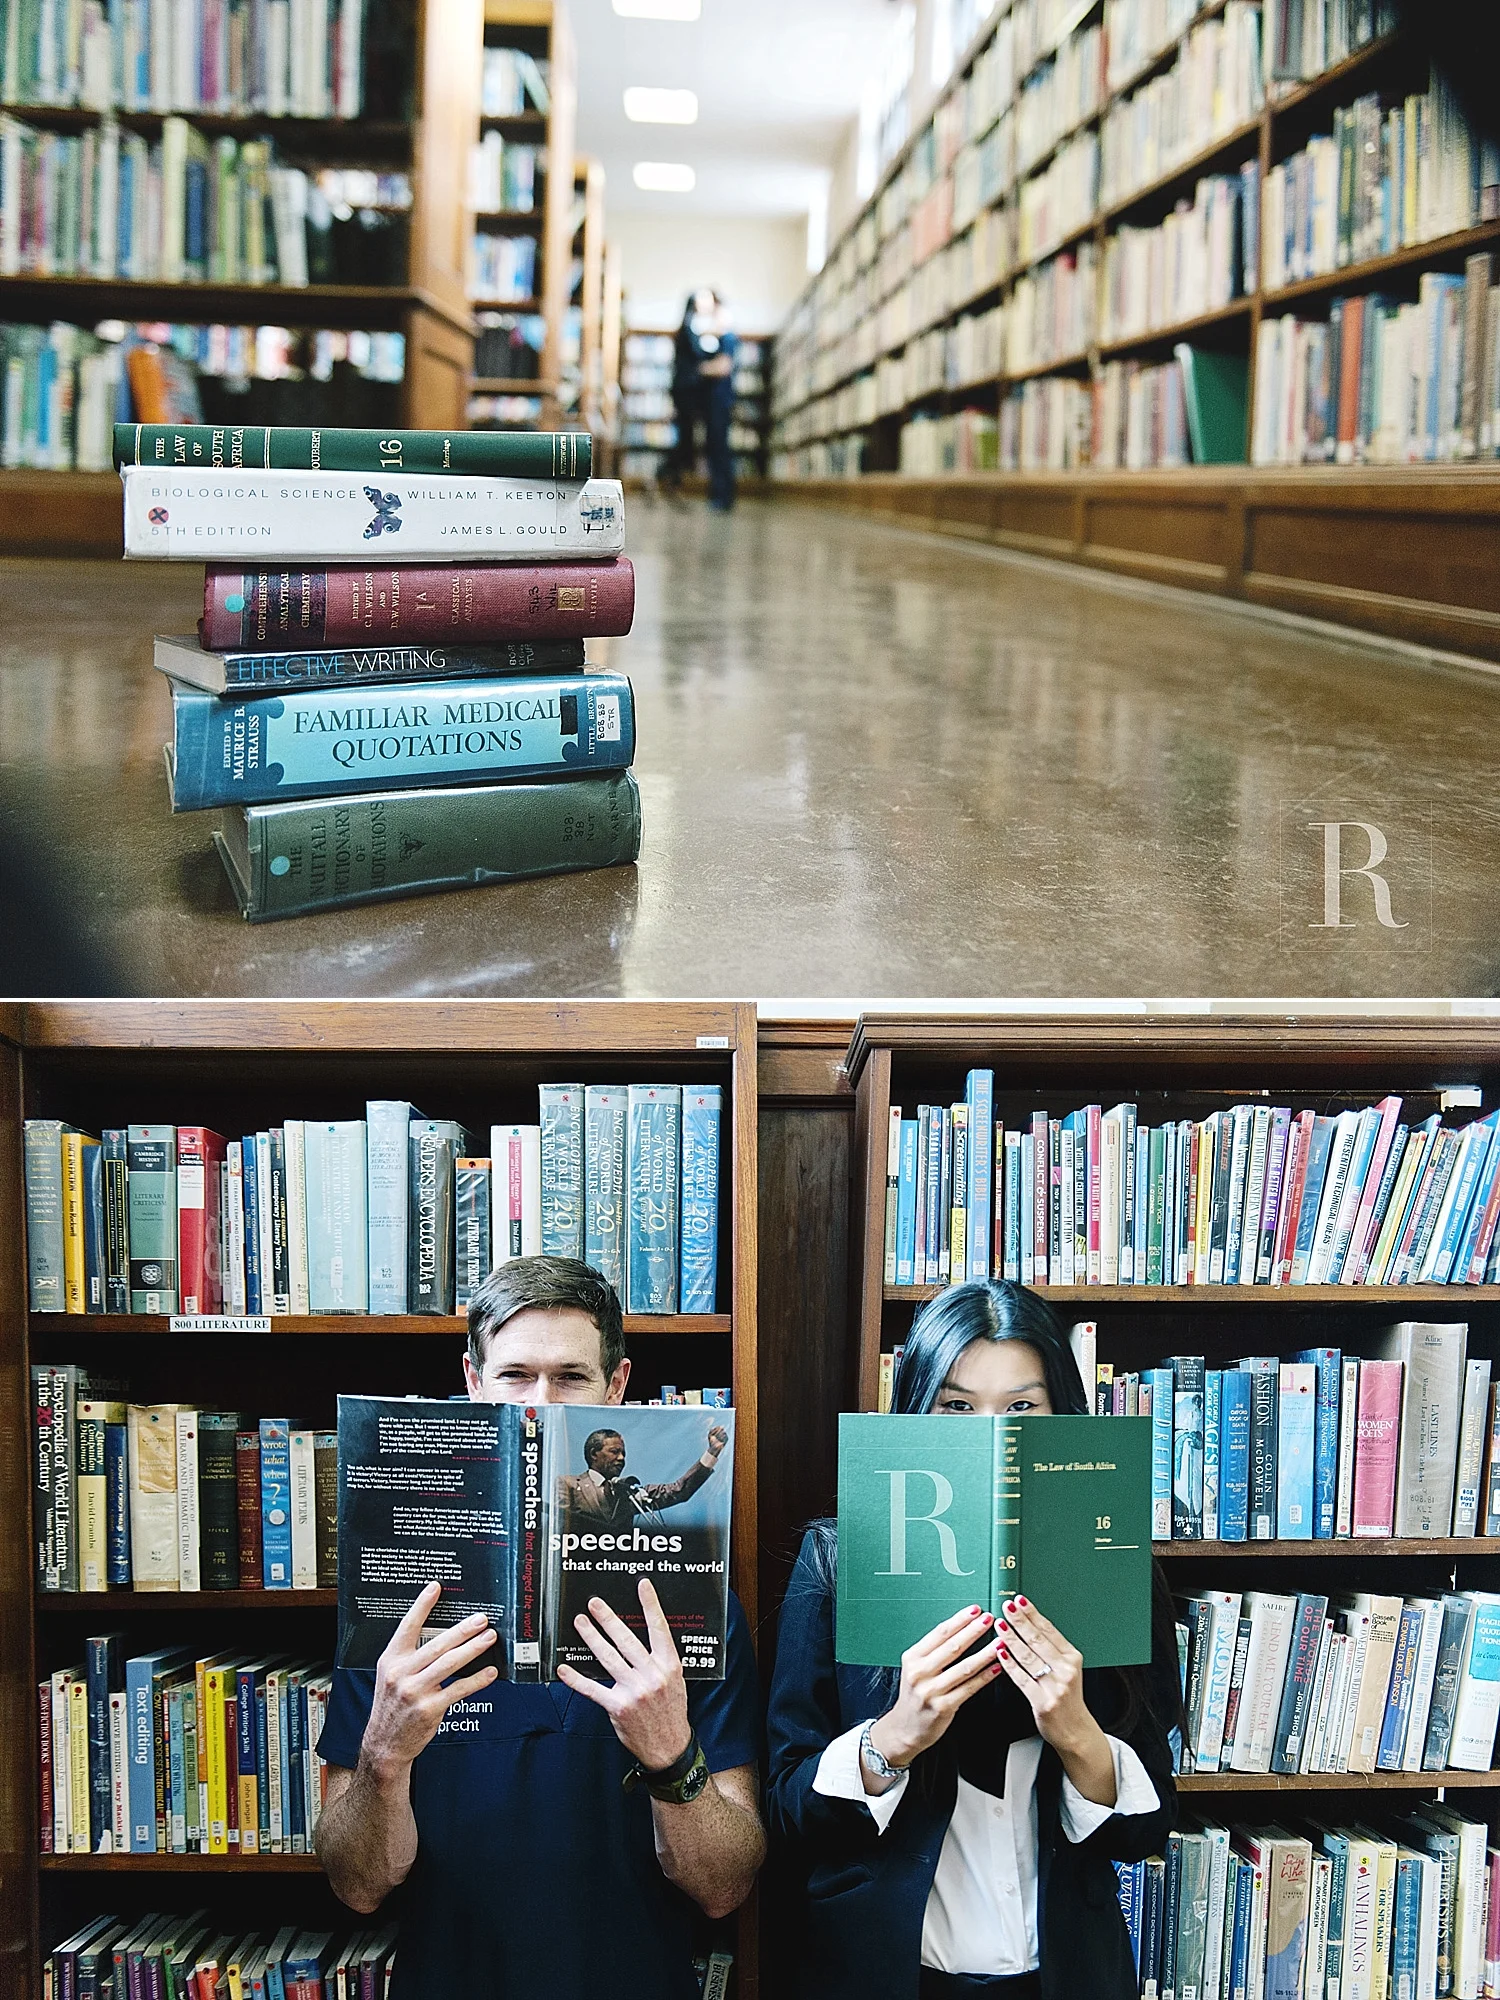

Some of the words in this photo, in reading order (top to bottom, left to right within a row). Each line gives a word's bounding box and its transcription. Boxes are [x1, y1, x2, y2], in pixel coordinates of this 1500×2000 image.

[155, 438, 165, 459] THE
[174, 435, 186, 463] LAW
[193, 442, 202, 457] OF
[379, 439, 403, 468] 16
[151, 487, 269, 499] BIOLOGICAL
[280, 489, 357, 499] SCIENCE
[407, 490, 477, 500] WILLIAM
[486, 490, 499, 500] T.
[505, 491, 567, 500] KEETON
[151, 526, 187, 536] 5TH
[194, 526, 272, 536] EDITION
[440, 525, 493, 535] JAMES
[499, 526, 512, 535] L.
[516, 525, 567, 535] GOULD
[280, 571, 289, 631] ANALYTICAL
[301, 572, 310, 628] CHEMISTRY
[365, 572, 373, 609] WILSON
[451, 576, 460, 625] CLASSICAL
[465, 578, 473, 622] ANALYSIS
[238, 655, 345, 681] EFFECTIVE
[352, 649, 446, 673] WRITING
[234, 706, 245, 719] B.
[293, 705, 431, 734] FAMILIAR
[443, 698, 561, 725] MEDICAL
[587, 688, 596, 722] BROWN
[607, 707, 615, 730] STR
[223, 720, 231, 732] BY
[223, 735, 231, 768] EDITED
[233, 722, 245, 780] MAURICE
[247, 715, 260, 769] STRAUSS
[332, 729, 522, 768] QUOTATIONS
[290, 847, 302, 876] THE
[311, 819, 326, 898] NUTTALL
[355, 844, 366, 863] OF
[975, 1079, 989, 1095] THE
[598, 1137, 611, 1147] of
[651, 1135, 664, 1144] of
[665, 1106, 675, 1193] ENCYCLOPEDIA
[975, 1097, 989, 1174] SCREENWRITER'S
[419, 1130, 438, 1185] READERS
[588, 1122, 598, 1195] LITERATURE
[612, 1110, 623, 1195] ENCYCLOPEDIA
[640, 1120, 650, 1192] LITERATURE
[1036, 1140, 1045, 1184] CONFLICT
[1271, 1134, 1285, 1169] BUILDING
[1336, 1134, 1354, 1180] PRESENTING
[600, 1150, 611, 1195] WORLD
[652, 1147, 662, 1192] WORLD
[953, 1130, 967, 1205] Screenwriting
[271, 1170, 281, 1218] Contemporary
[974, 1177, 988, 1202] BIBLE
[1035, 1186, 1046, 1197] &
[1267, 1170, 1281, 1197] BETTER
[1264, 1199, 1277, 1222] PLOTS
[1327, 1181, 1344, 1220] TECHNICAL
[273, 1219, 281, 1245] Literary
[588, 1200, 596, 1235] CENTURY
[1036, 1198, 1045, 1244] SUSPENSE
[419, 1190, 435, 1281] ENCYCLOPEDIA
[467, 1217, 479, 1258] LITERARY
[1322, 1222, 1334, 1245] IDEAS
[273, 1246, 282, 1271] Theory
[467, 1259, 479, 1288] TERMS
[174, 1320, 192, 1329] 800
[194, 1320, 269, 1330] LITERATURE
[1424, 1334, 1443, 1344] Kline
[38, 1373, 51, 1386] in
[37, 1387, 51, 1407] the
[47, 1373, 68, 1448] Encyclopedia
[1357, 1420, 1394, 1430] WOMEN
[1429, 1404, 1440, 1428] LAST
[179, 1425, 188, 1463] LITERARY
[262, 1441, 286, 1450] wrote
[1204, 1419, 1219, 1464] AGES
[1321, 1413, 1330, 1457] MENAGERIE
[1357, 1429, 1384, 1438] POETS
[1429, 1430, 1439, 1458] LINES
[33, 1441, 52, 1492] Century
[53, 1455, 68, 1468] of
[264, 1456, 285, 1465] what
[1033, 1463, 1048, 1472] The
[1048, 1463, 1064, 1472] Law
[1073, 1462, 1095, 1471] South
[1095, 1462, 1117, 1471] Africa
[1154, 1417, 1170, 1495] DREAMS
[264, 1470, 288, 1479] when
[521, 1442, 541, 1530] speeches
[1254, 1439, 1264, 1508] McDOWELL
[1264, 1454, 1273, 1493] COLIN
[54, 1471, 69, 1509] World
[88, 1492, 96, 1516] David
[181, 1488, 189, 1531] THEMATIC
[1095, 1516, 1111, 1530] 16
[55, 1510, 70, 1571] Literature
[181, 1533, 190, 1561] TERMS
[525, 1531, 535, 1552] that
[549, 1528, 682, 1558] speeches
[522, 1554, 535, 1593] changed
[562, 1559, 592, 1571] that
[595, 1560, 654, 1574] changed
[657, 1560, 681, 1572] the
[685, 1560, 724, 1573] world
[999, 1556, 1016, 1570] 16
[524, 1595, 534, 1609] the
[1304, 1605, 1314, 1622] OF
[524, 1611, 534, 1638] world
[1197, 1615, 1206, 1633] 20th
[1312, 1607, 1323, 1633] THE
[1371, 1613, 1397, 1623] Cassell's
[681, 1635, 719, 1645] SPECIAL
[1268, 1621, 1282, 1652] LEND
[1299, 1626, 1311, 1651] OUR
[1398, 1617, 1410, 1650] LEONARD
[565, 1653, 593, 1662] Simon
[681, 1657, 716, 1668] £9.99
[685, 1646, 713, 1655] PRICE
[1193, 1634, 1204, 1663] Century
[1231, 1636, 1250, 1689] INFAMOUS
[1303, 1638, 1319, 1684] WORDS
[1395, 1651, 1405, 1671] LOUIS
[1207, 1626, 1233, 1722] MONEY
[1265, 1657, 1276, 1673] ME
[1294, 1655, 1306, 1683] TIME
[136, 1684, 149, 1714] Text
[240, 1684, 249, 1708] College
[1189, 1673, 1199, 1711] Quotations
[1261, 1677, 1273, 1709] YOUR
[1295, 1691, 1304, 1713] JOHN
[1391, 1671, 1403, 1706] LEVINSON
[40, 1696, 49, 1738] NON-FICTION
[240, 1710, 249, 1735] Writing
[135, 1716, 150, 1764] editing
[242, 1736, 250, 1753] Skills
[291, 1716, 300, 1748] Handbook
[41, 1740, 50, 1764] BOOKS
[114, 1741, 122, 1773] EDITING
[114, 1781, 122, 1802] Mary
[242, 1800, 250, 1824] Langan
[1378, 1888, 1386, 1907] FOR
[1437, 1844, 1456, 1939] APHORISMS
[1352, 1871, 1371, 1973] AANHALINGS
[1375, 1908, 1385, 1953] SPEAKERS
[1402, 1906, 1410, 1956] QUOTATIONS
